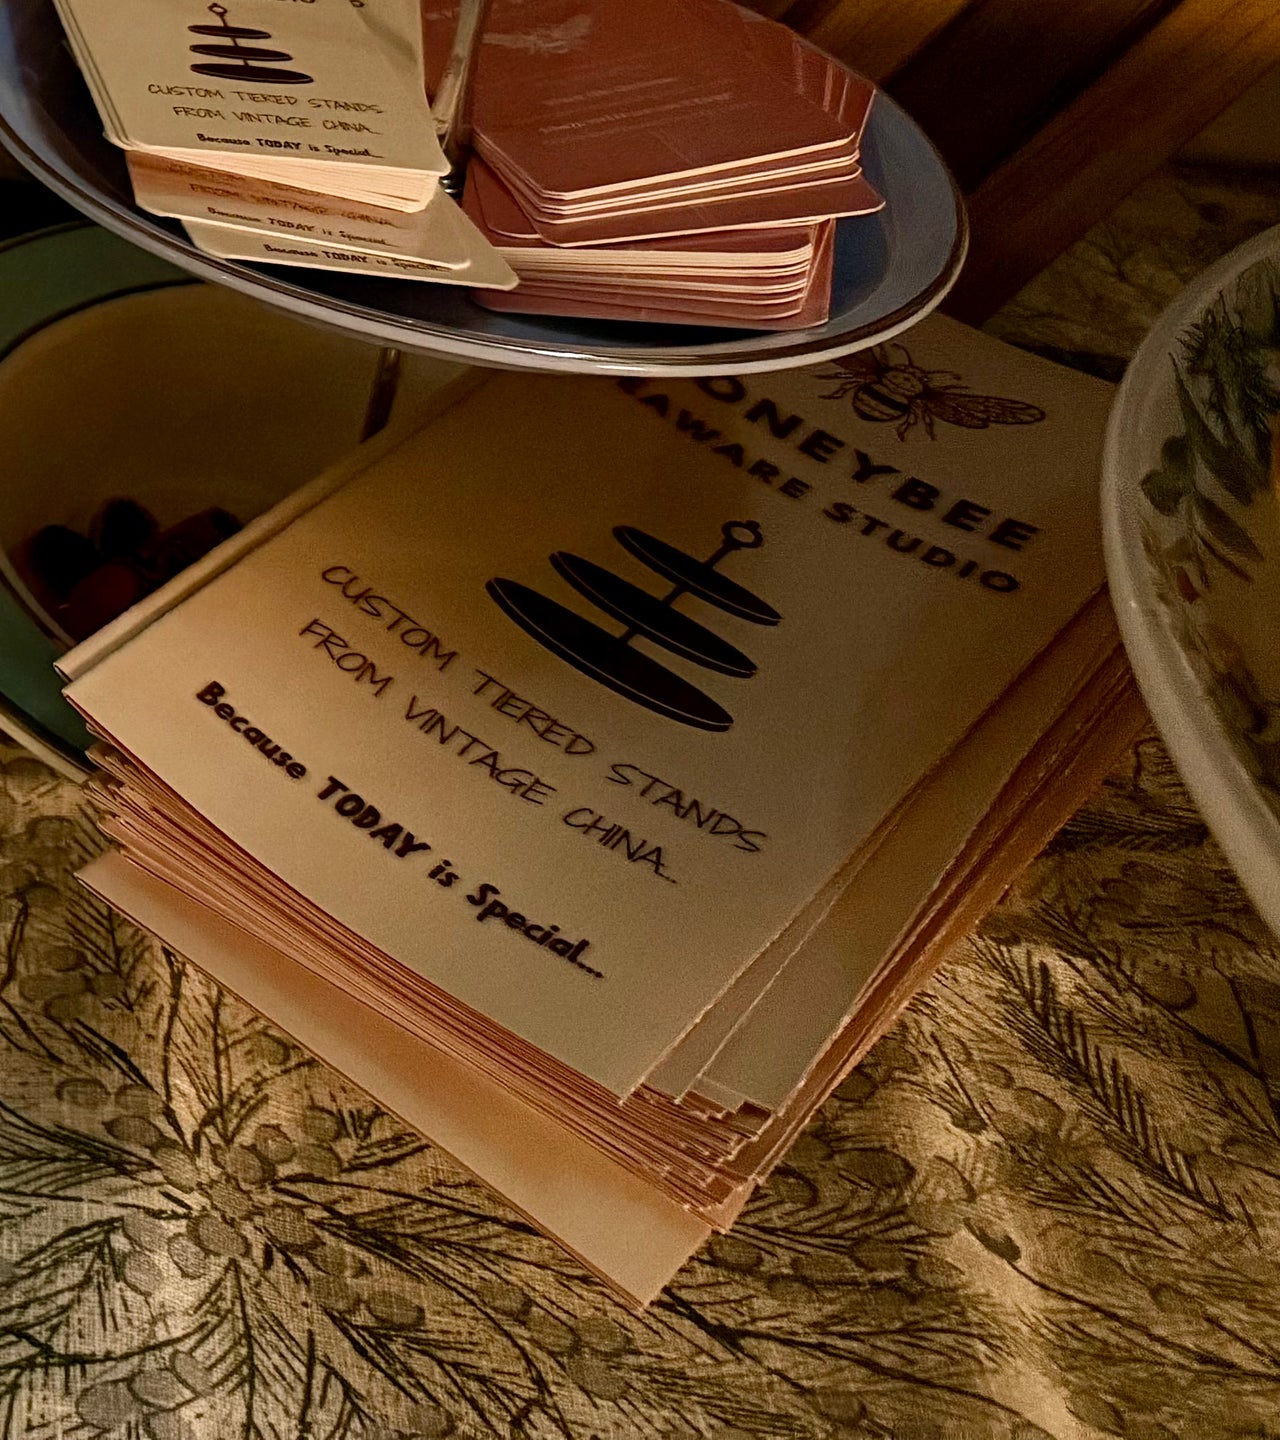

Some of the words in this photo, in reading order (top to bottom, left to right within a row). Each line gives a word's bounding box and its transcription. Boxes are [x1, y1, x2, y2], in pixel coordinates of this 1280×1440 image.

[148, 83, 224, 100] CUSTOM
[231, 90, 298, 105] TIERED
[308, 98, 384, 114] STANDS
[173, 106, 225, 121] FROM
[232, 111, 312, 128] VINTAGE
[196, 133, 251, 146] Because
[255, 138, 301, 150] TODAY
[308, 144, 320, 152] is
[267, 217, 315, 232] TODAY
[321, 250, 367, 264] TODAY
[697, 374, 1041, 553] ONEYBEE
[821, 501, 1021, 594] STUDIO
[298, 617, 395, 698] FROM
[404, 695, 557, 806] VINTAGE
[320, 564, 461, 673] CUSTOM
[472, 668, 597, 757] TIERED
[603, 762, 770, 854] STANDS
[195, 679, 309, 781] Because
[316, 775, 432, 861] TODAY
[428, 859, 461, 889] is
